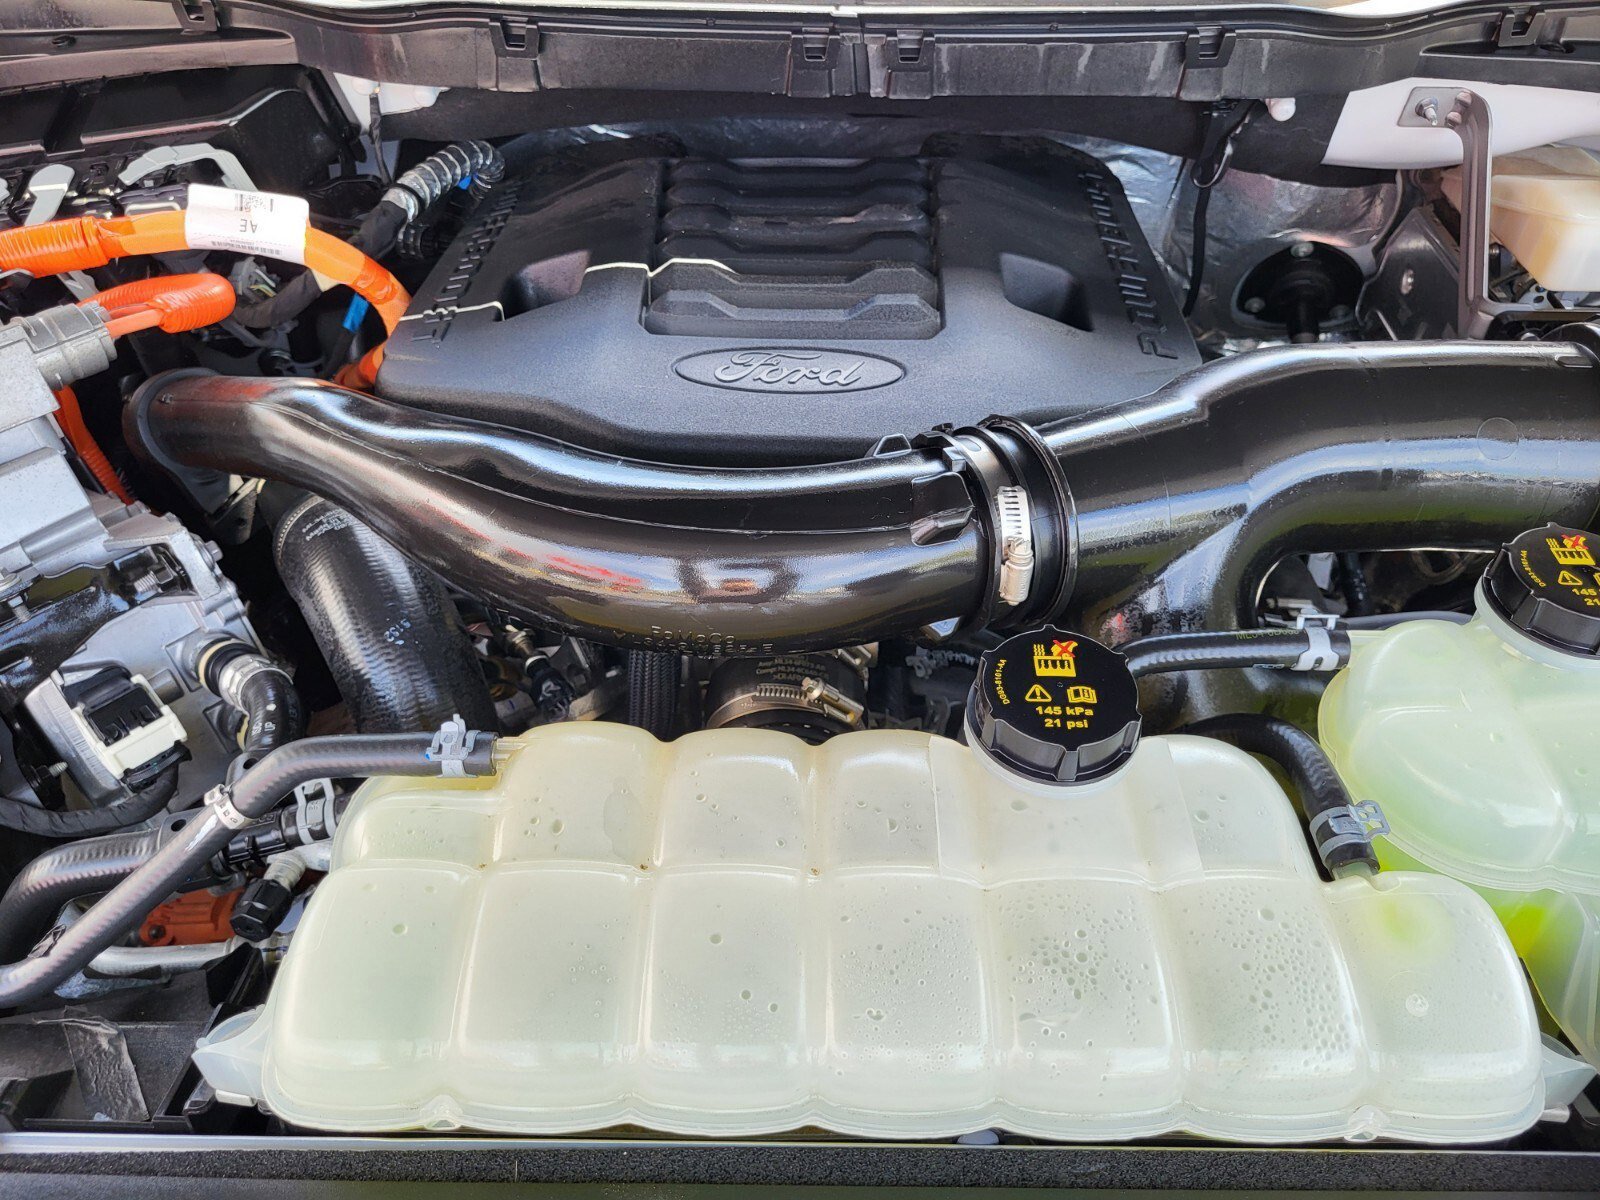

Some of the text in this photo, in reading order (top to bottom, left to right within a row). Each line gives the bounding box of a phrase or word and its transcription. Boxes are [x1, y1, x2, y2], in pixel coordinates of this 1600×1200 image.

[714, 351, 865, 387] Ford
[1571, 588, 1598, 596] 145
[1035, 705, 1095, 716] 145 kPa
[1044, 718, 1089, 730] 21 psi
